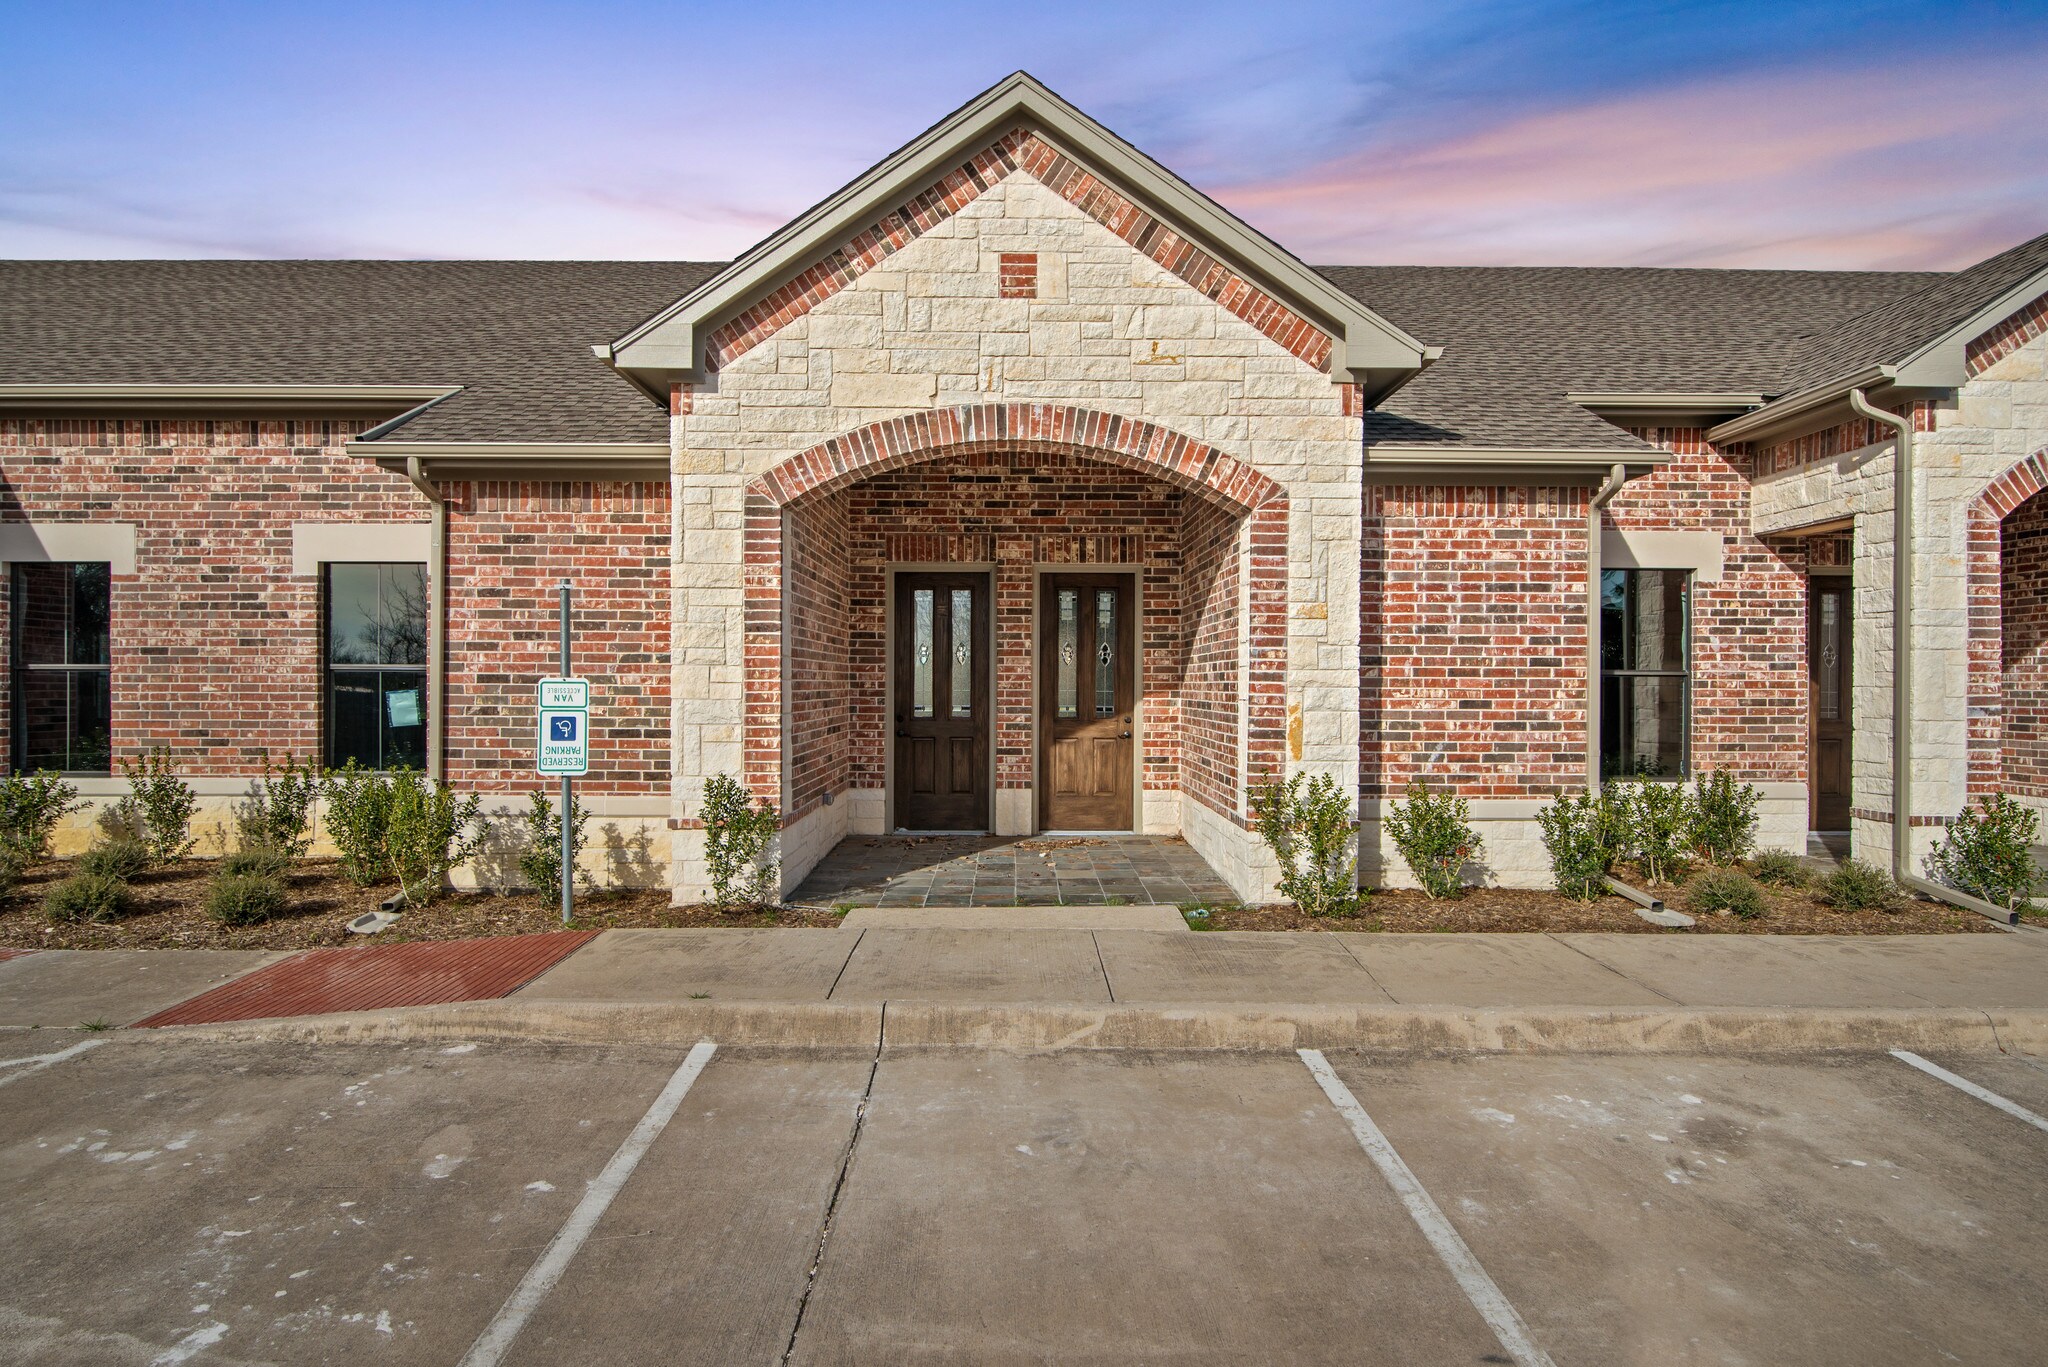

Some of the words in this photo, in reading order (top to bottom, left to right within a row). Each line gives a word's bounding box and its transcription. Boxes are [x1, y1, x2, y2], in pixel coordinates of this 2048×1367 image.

[553, 694, 573, 702] VAN
[545, 746, 581, 755] PARKING
[542, 757, 583, 766] RESERVED
